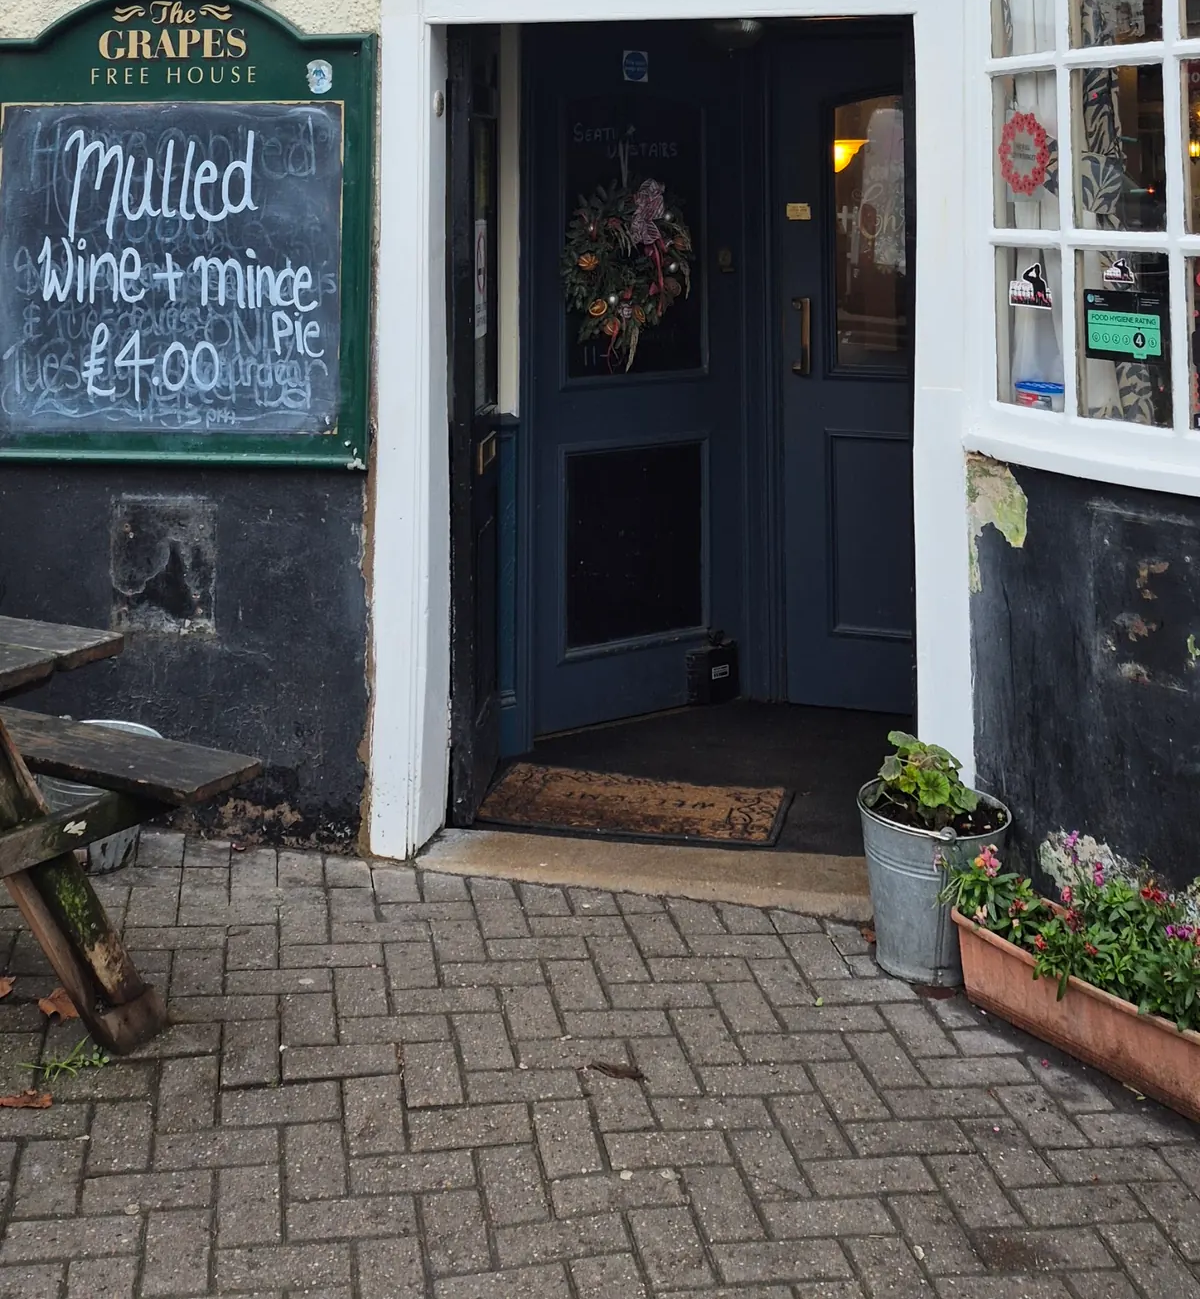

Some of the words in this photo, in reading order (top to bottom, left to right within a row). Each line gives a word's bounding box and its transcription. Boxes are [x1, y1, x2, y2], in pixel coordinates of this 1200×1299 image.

[149, 0, 197, 25] The
[98, 28, 247, 60] GRAPES
[91, 67, 149, 85] FREE
[167, 65, 256, 84] HOUSE
[64, 129, 259, 242] Mulled
[152, 252, 183, 302] +
[193, 247, 318, 312] mince
[271, 310, 324, 358] Pie
[1091, 313, 1108, 321] FOOD
[1109, 315, 1134, 323] HYGIENE
[1135, 317, 1156, 325] RATING
[82, 322, 219, 402] £4.00
